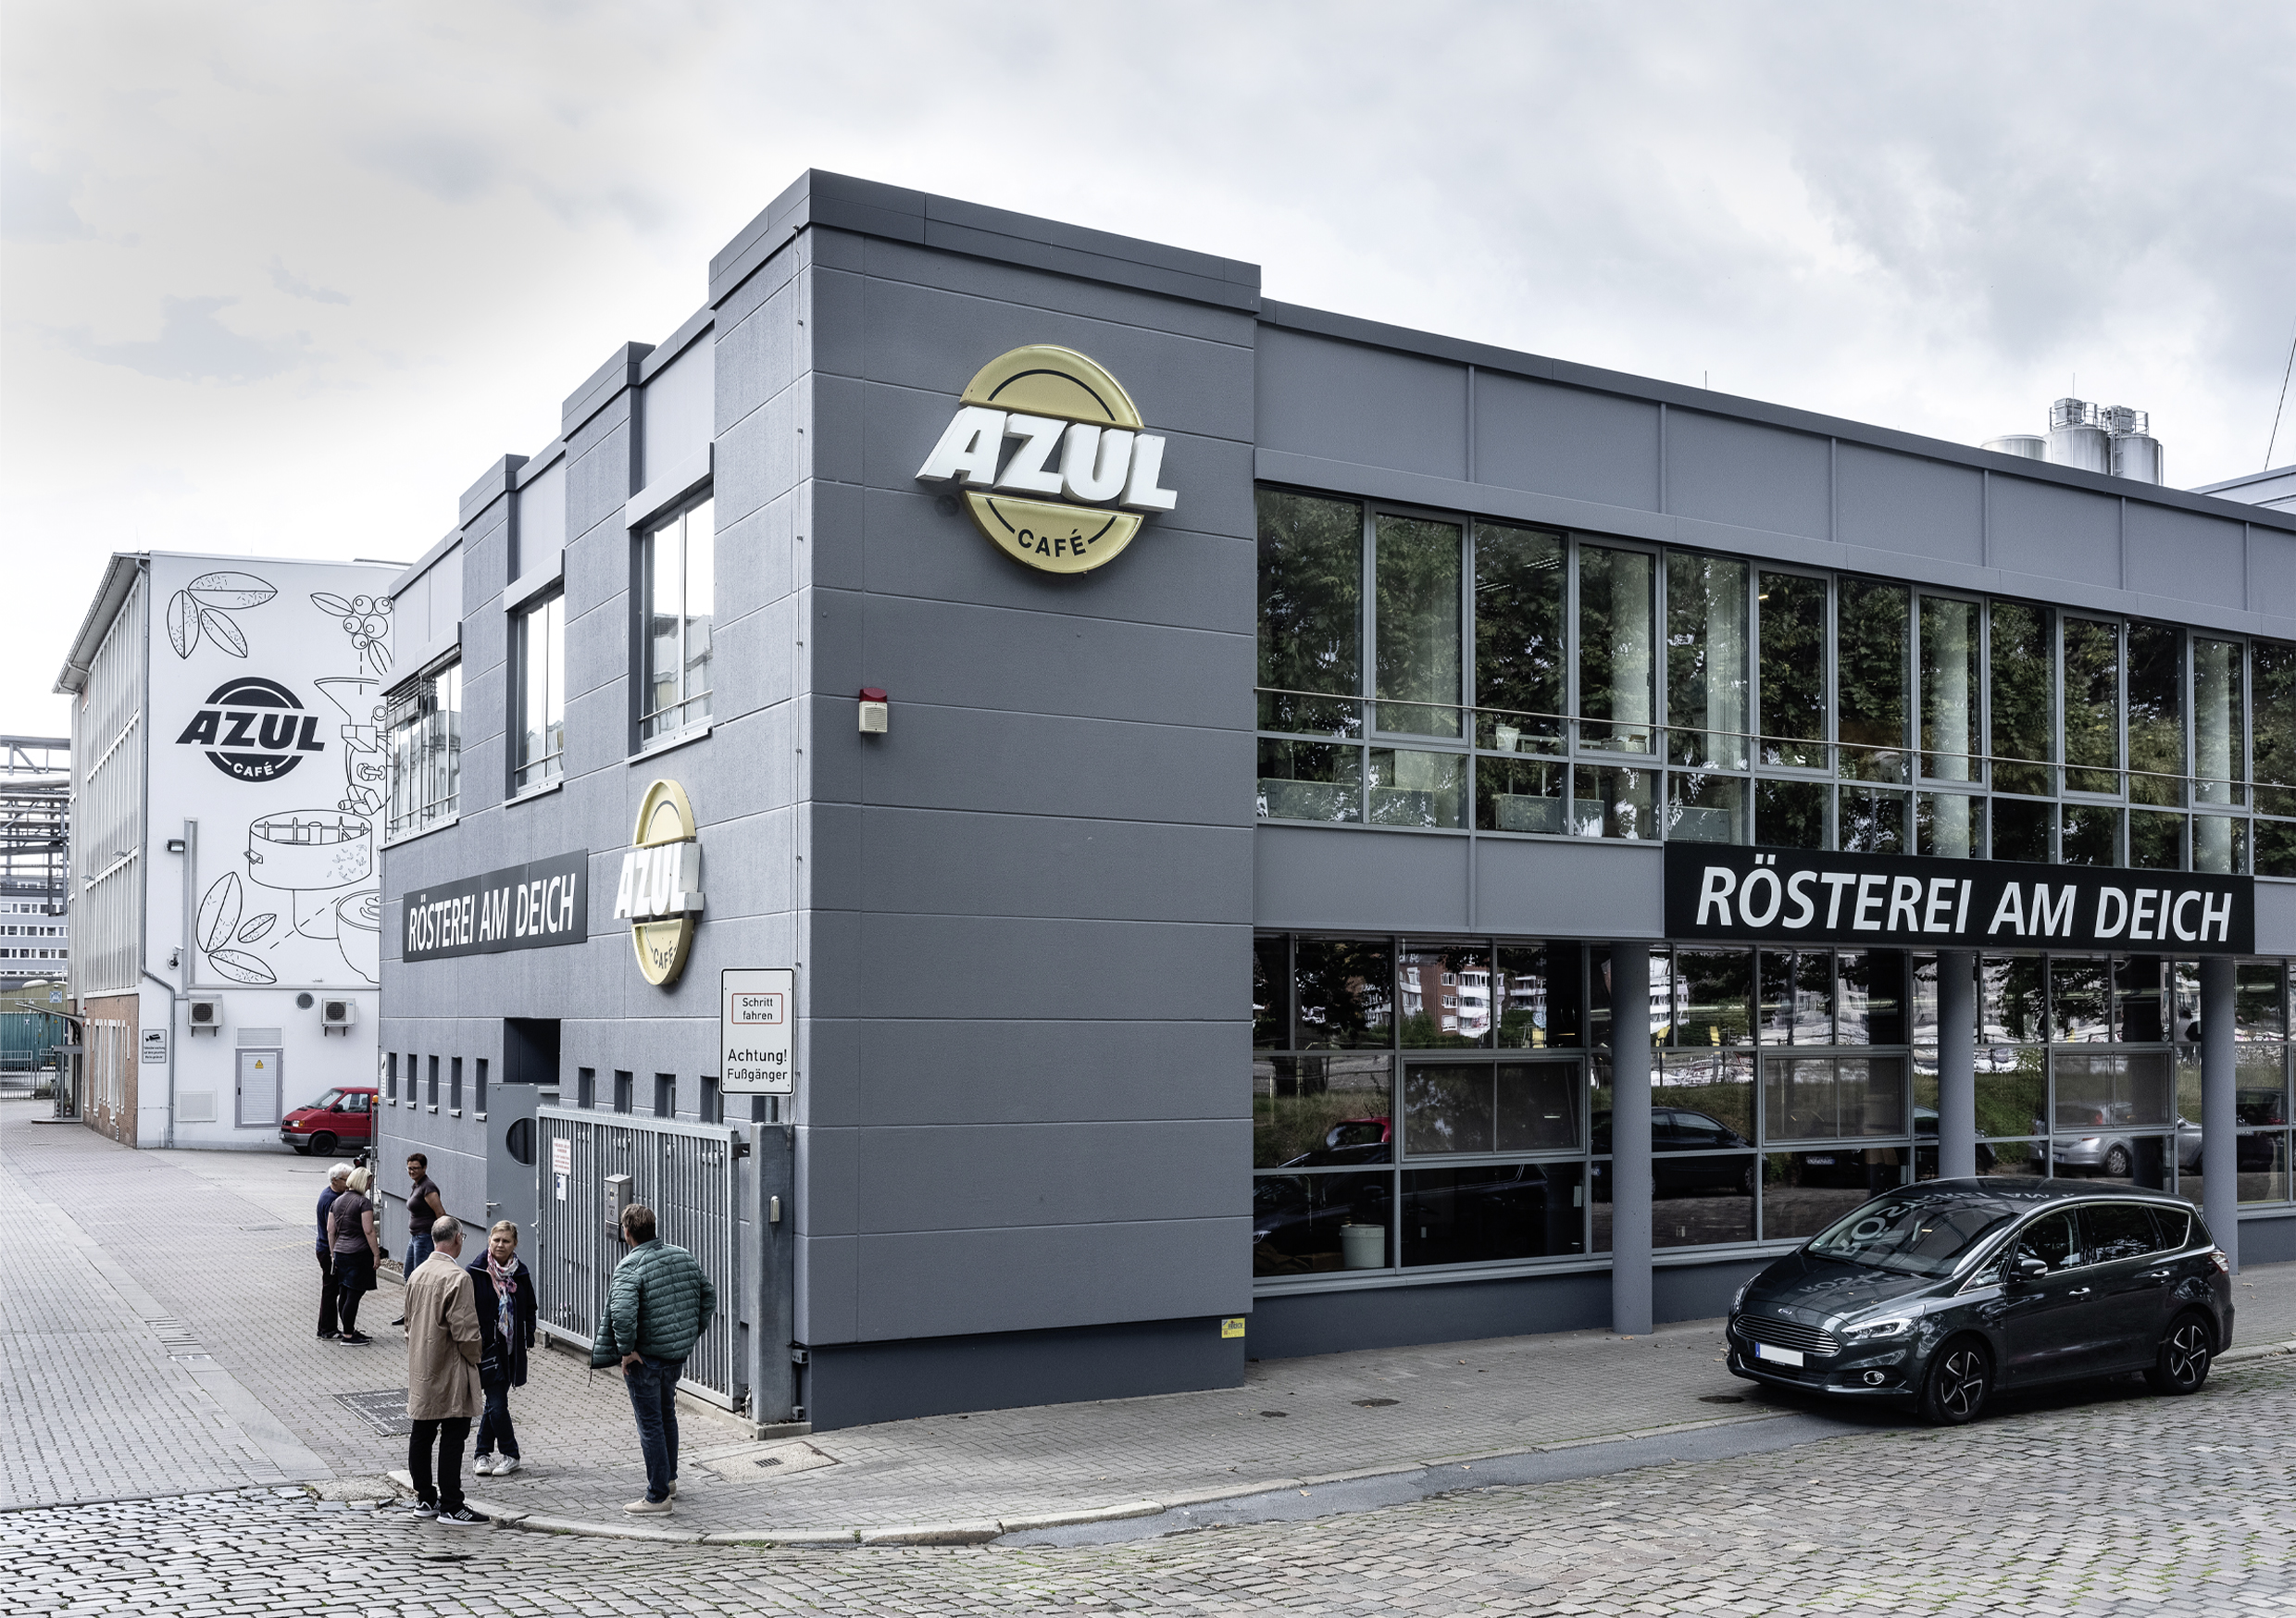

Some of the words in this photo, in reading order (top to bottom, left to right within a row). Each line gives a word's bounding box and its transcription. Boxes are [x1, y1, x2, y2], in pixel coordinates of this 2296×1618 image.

[915, 405, 1178, 510] AZUL
[1017, 529, 1086, 557] CAFÉ
[175, 710, 326, 752] AZUL
[233, 762, 274, 777] CAFÉ
[613, 842, 687, 919] AZUL
[1696, 854, 1973, 934] RÖSTEREI
[1988, 882, 2077, 937] AM
[2094, 886, 2232, 941] DEICH
[408, 894, 475, 952] RÖSTEREI
[479, 888, 509, 942] AM
[516, 873, 575, 938] DEICH
[742, 998, 773, 1007] Schritt
[742, 1011, 773, 1020] fahren
[728, 1049, 788, 1065] Achtung!
[728, 1068, 788, 1082] Fußgänger
